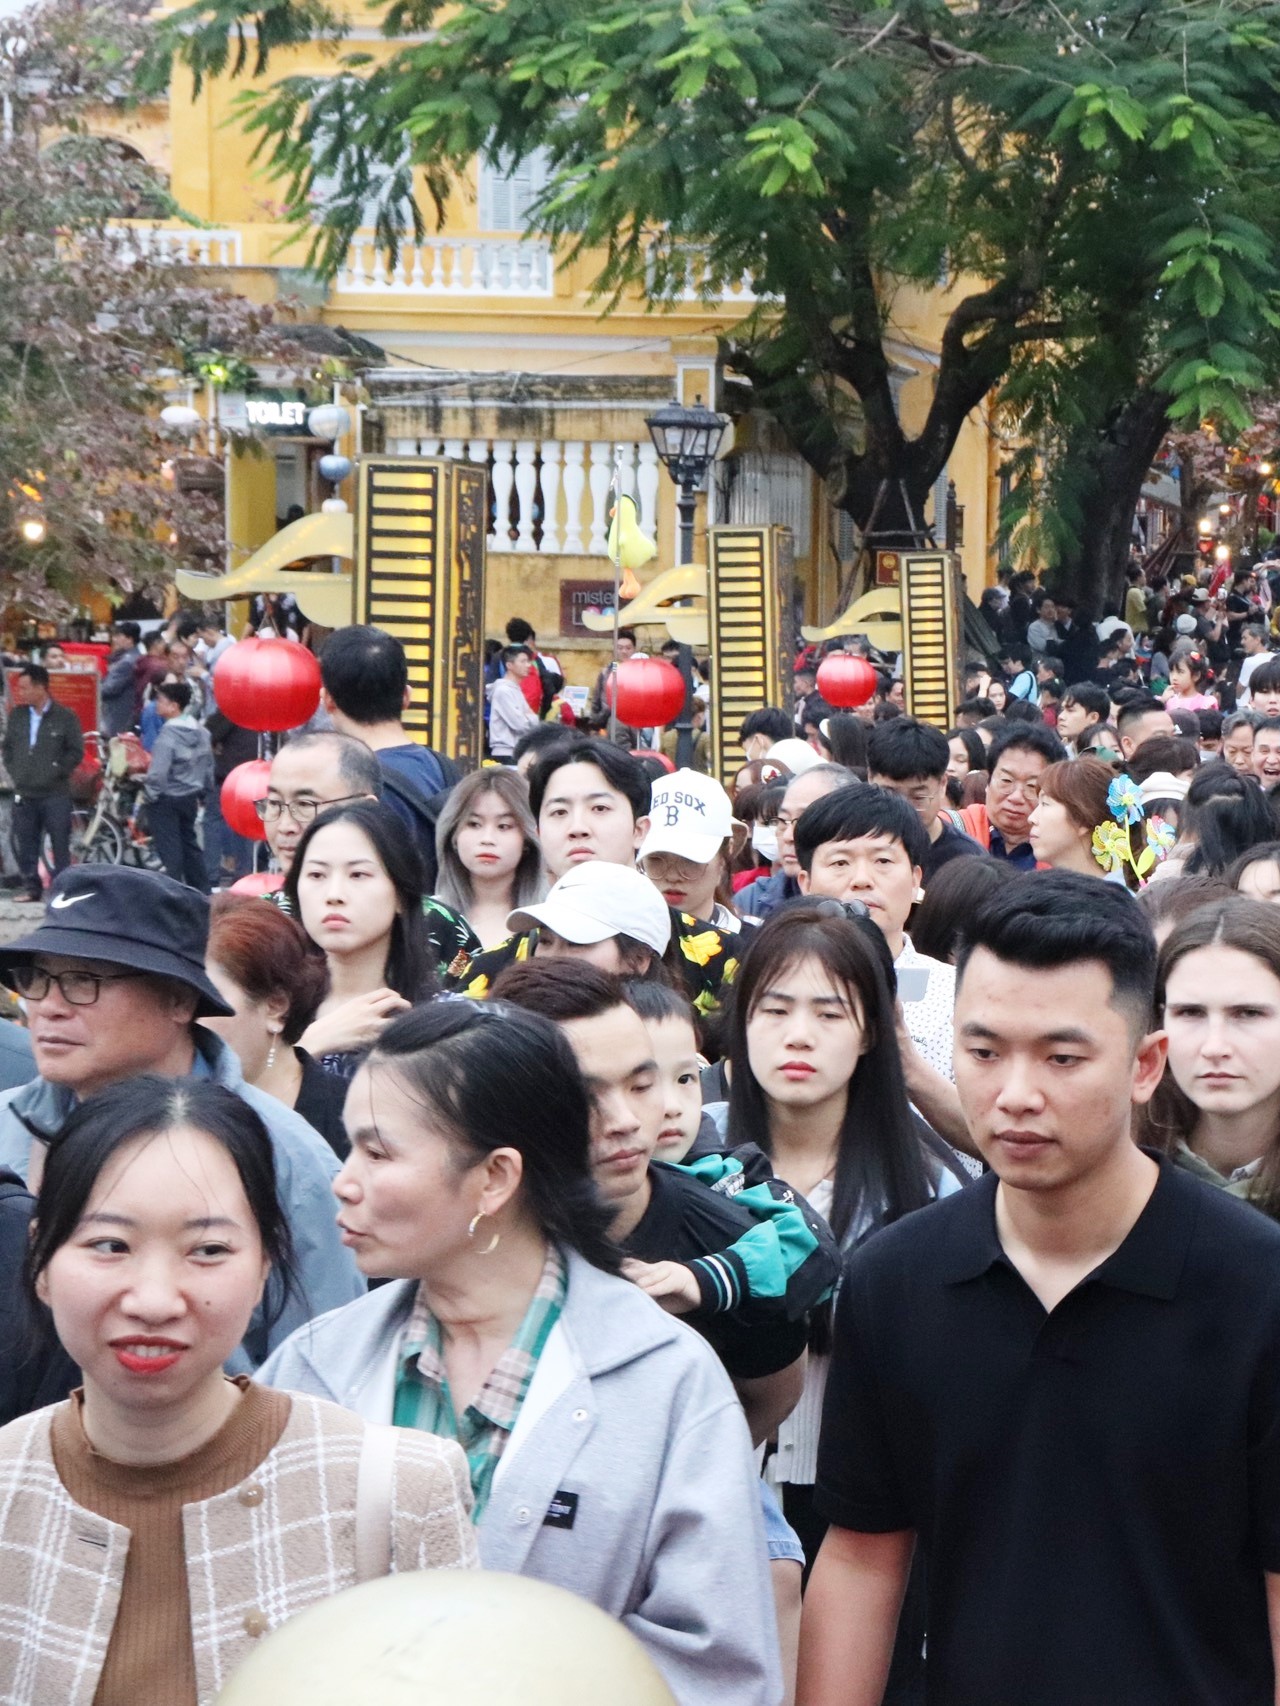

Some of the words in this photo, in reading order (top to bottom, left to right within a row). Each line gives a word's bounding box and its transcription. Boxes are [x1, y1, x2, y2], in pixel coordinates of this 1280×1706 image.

[245, 401, 306, 425] TOILET
[652, 791, 669, 809] ED
[674, 791, 706, 817] SOX
[663, 805, 679, 827] B
